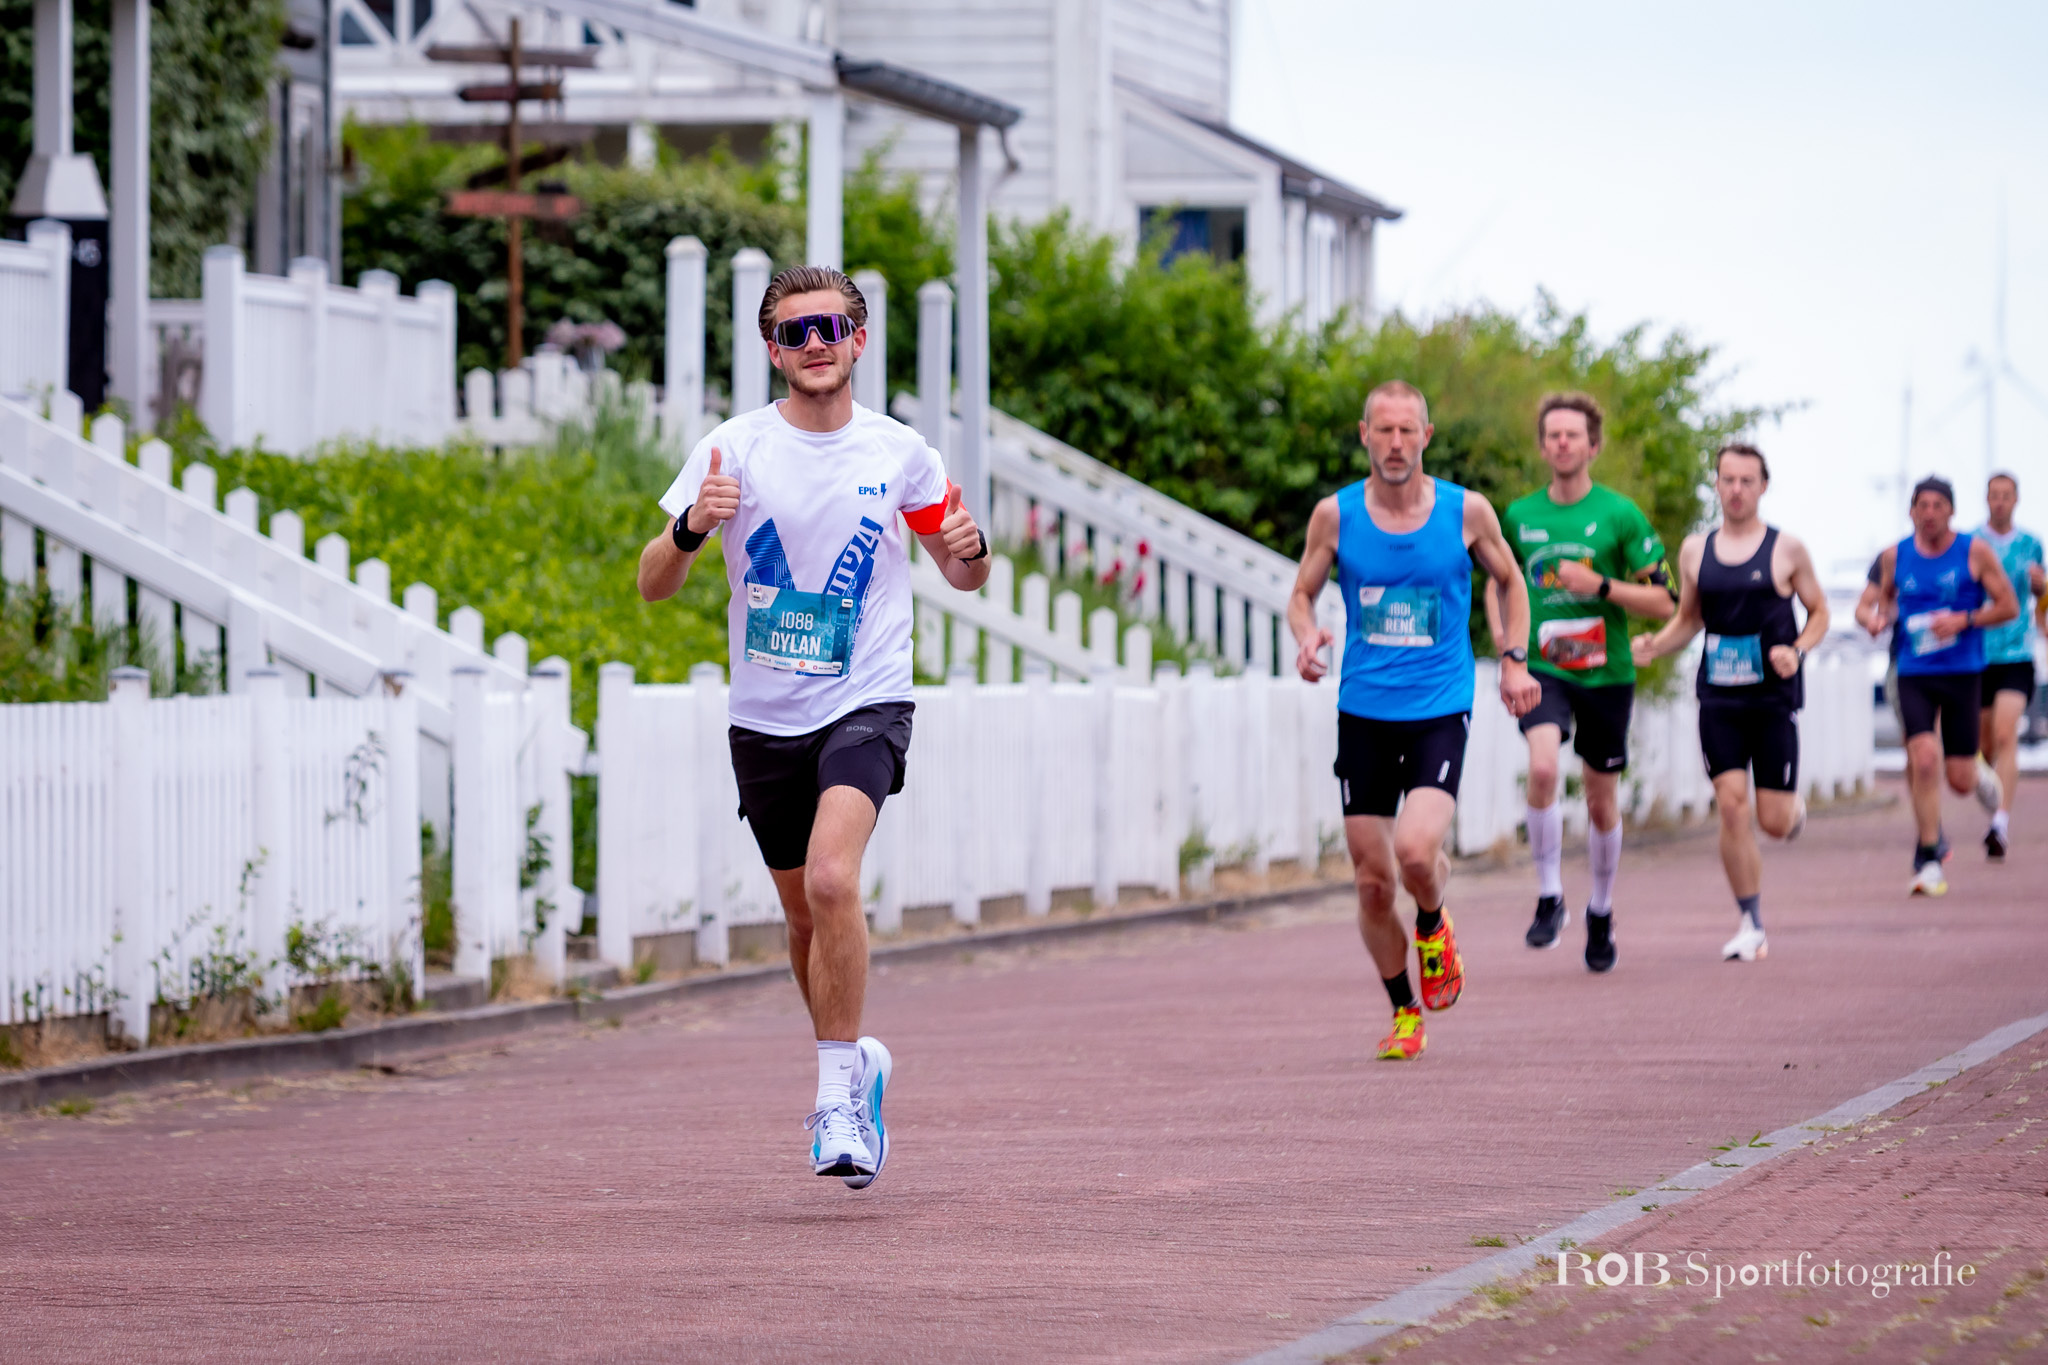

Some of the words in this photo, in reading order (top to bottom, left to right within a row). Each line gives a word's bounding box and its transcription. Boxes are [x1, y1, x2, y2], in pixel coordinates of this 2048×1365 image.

[858, 485, 878, 496] EPIC
[780, 611, 814, 631] 1088
[771, 631, 821, 656] DYLAN
[846, 725, 874, 734] BORG
